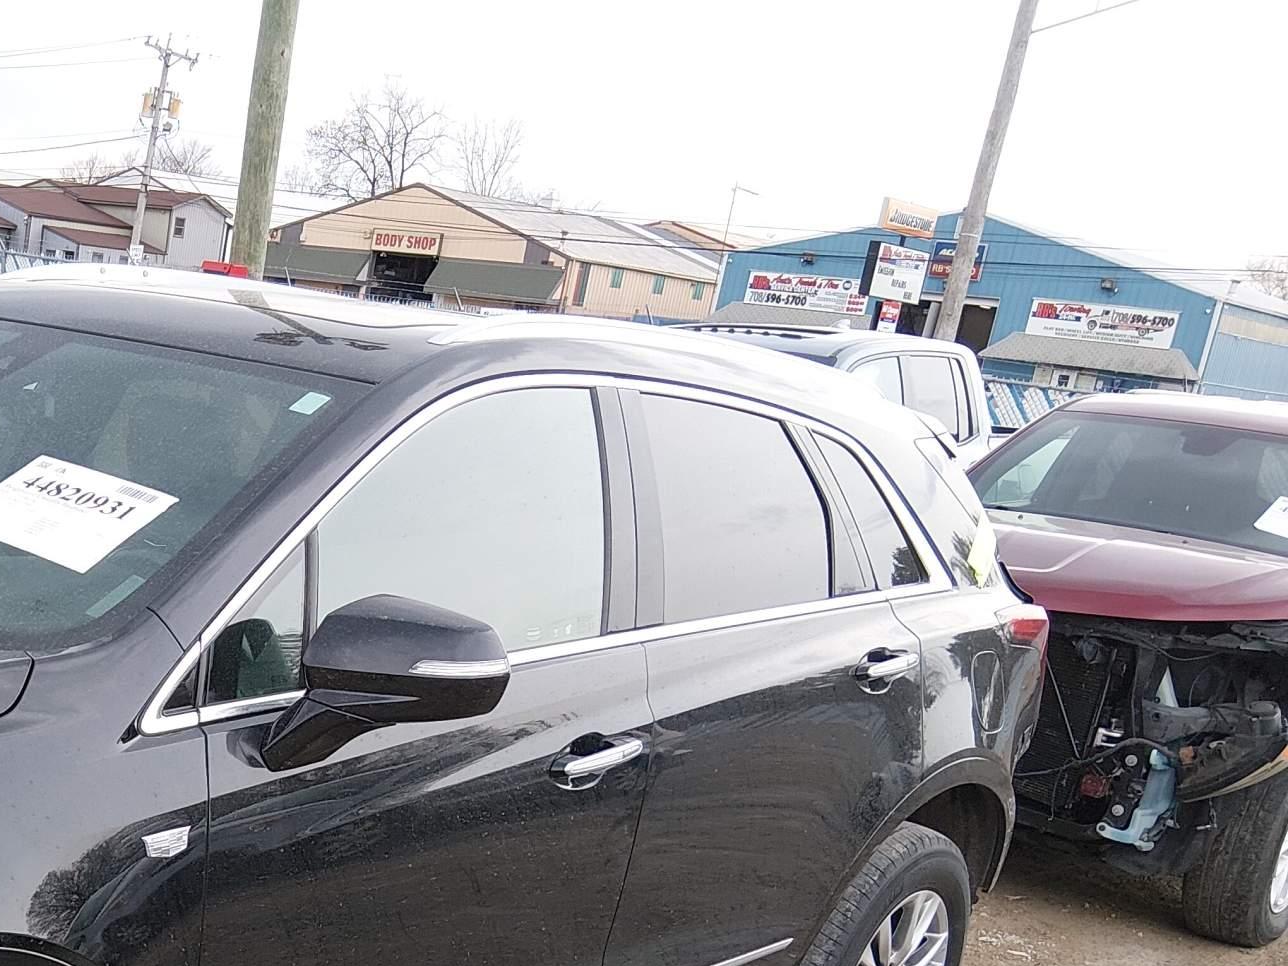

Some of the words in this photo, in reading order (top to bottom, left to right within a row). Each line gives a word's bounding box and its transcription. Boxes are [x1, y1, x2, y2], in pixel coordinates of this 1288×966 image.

[890, 209, 934, 232] BRIDGESTONE
[375, 233, 404, 248] BODY
[406, 235, 437, 251] SHOP
[22, 475, 136, 519] 44820931
